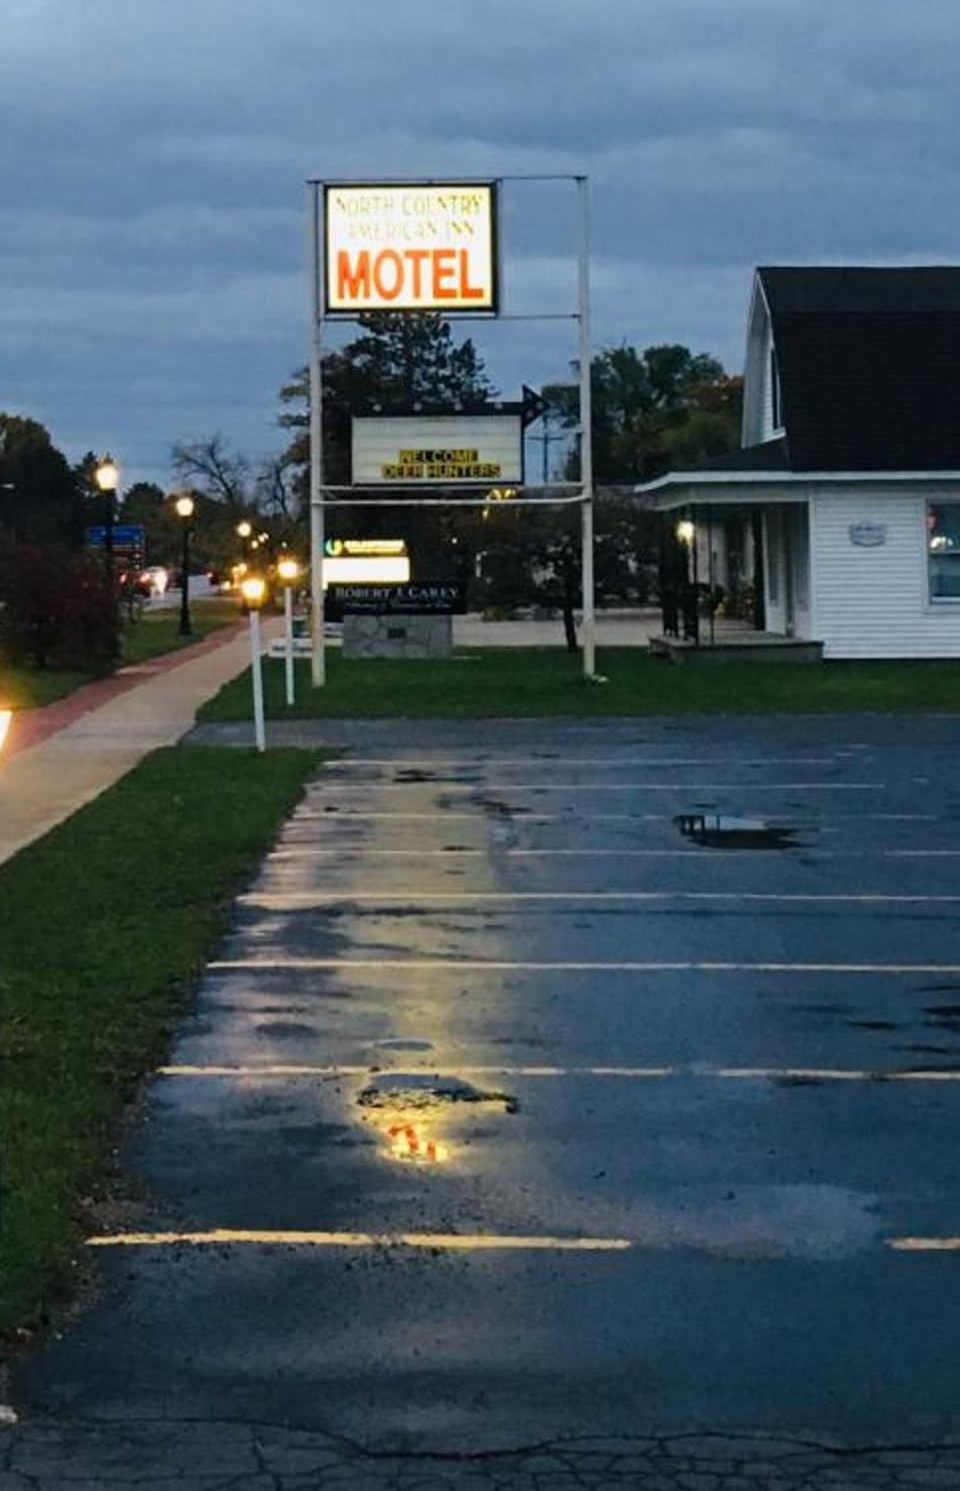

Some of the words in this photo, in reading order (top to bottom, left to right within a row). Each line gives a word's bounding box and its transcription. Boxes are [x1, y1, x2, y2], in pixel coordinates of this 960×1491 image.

[336, 195, 394, 215] NORTH
[402, 194, 482, 215] COUNTRY
[337, 248, 485, 300] MOTEL
[399, 449, 478, 463] WELCOME
[382, 464, 422, 479] DEER
[426, 463, 501, 479] HUNTERS
